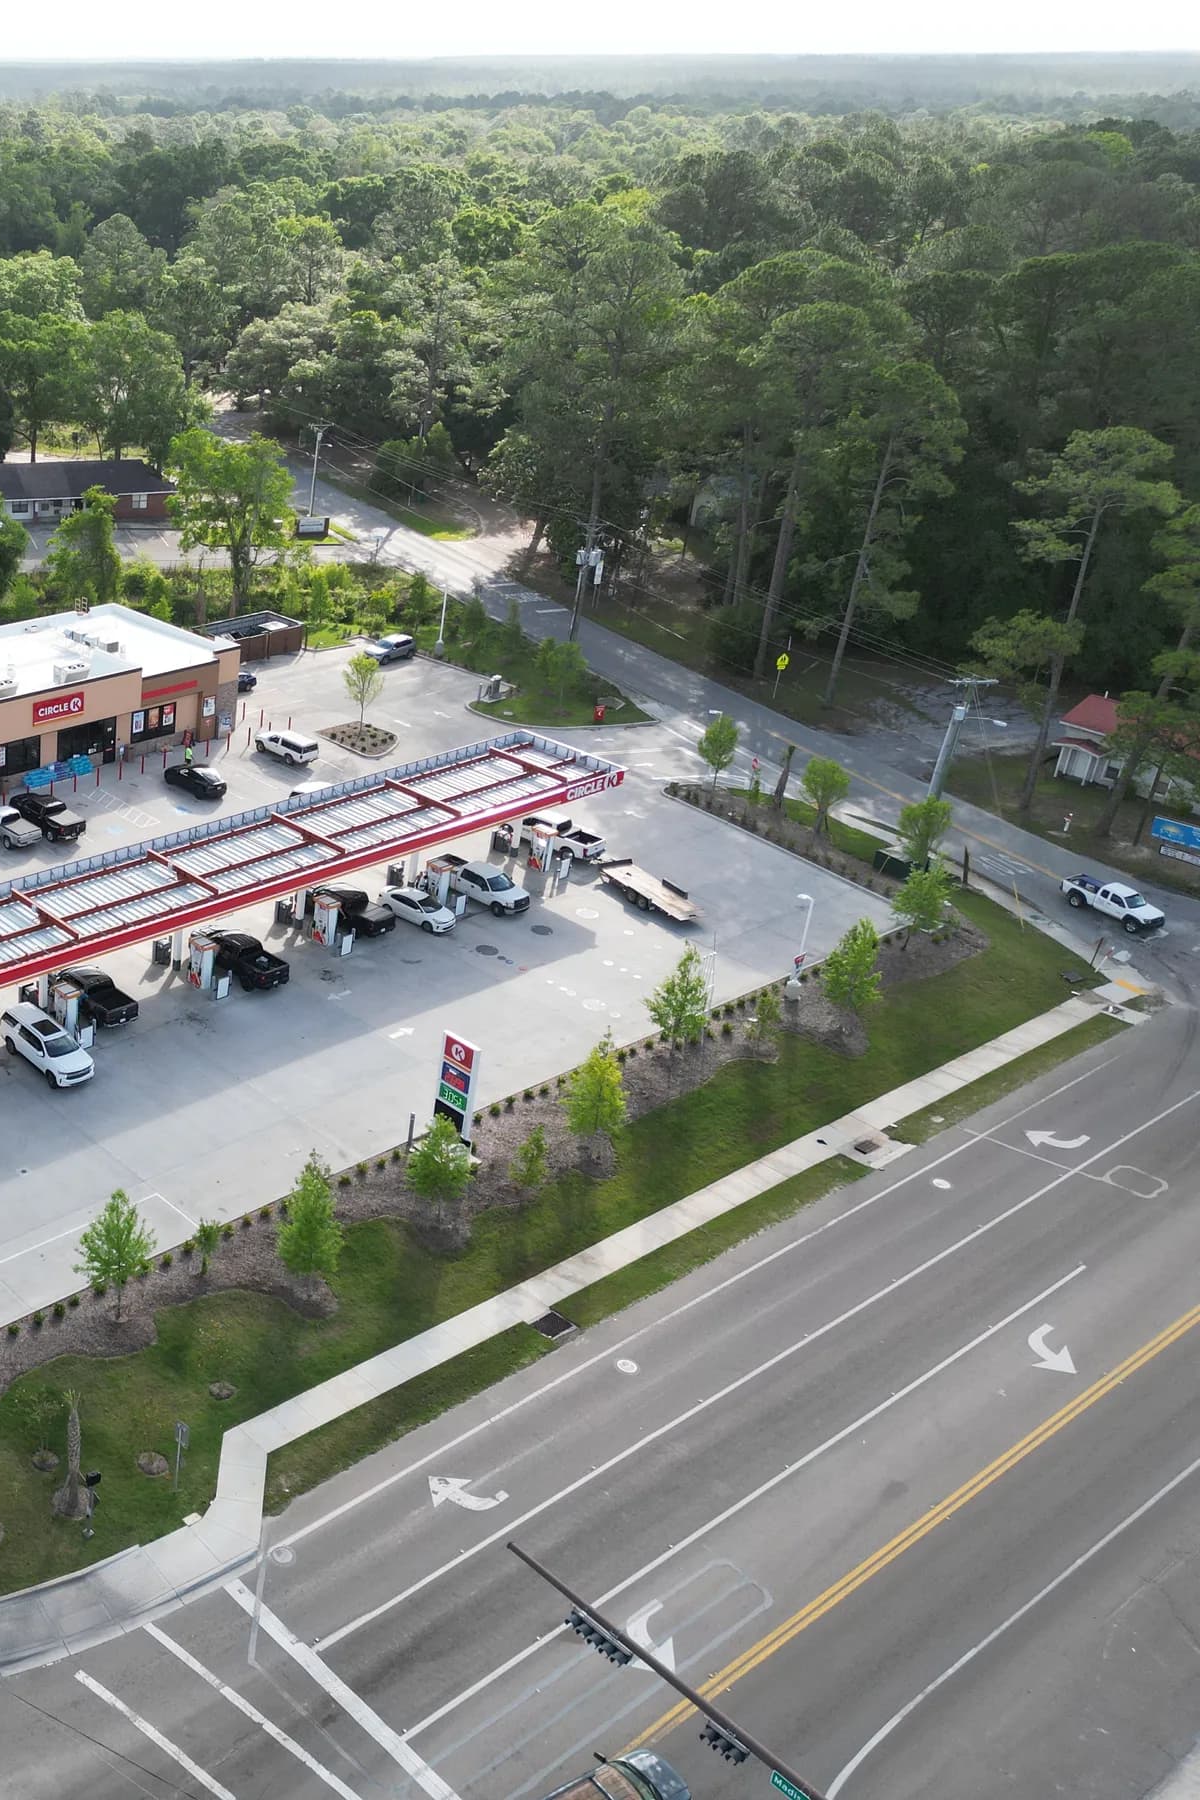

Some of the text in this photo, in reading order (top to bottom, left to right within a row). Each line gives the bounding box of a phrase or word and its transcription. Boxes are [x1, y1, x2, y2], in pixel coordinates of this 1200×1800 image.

[38, 698, 81, 717] CIRCLE K
[566, 774, 617, 800] CIRCLE K
[454, 1046, 464, 1060] K
